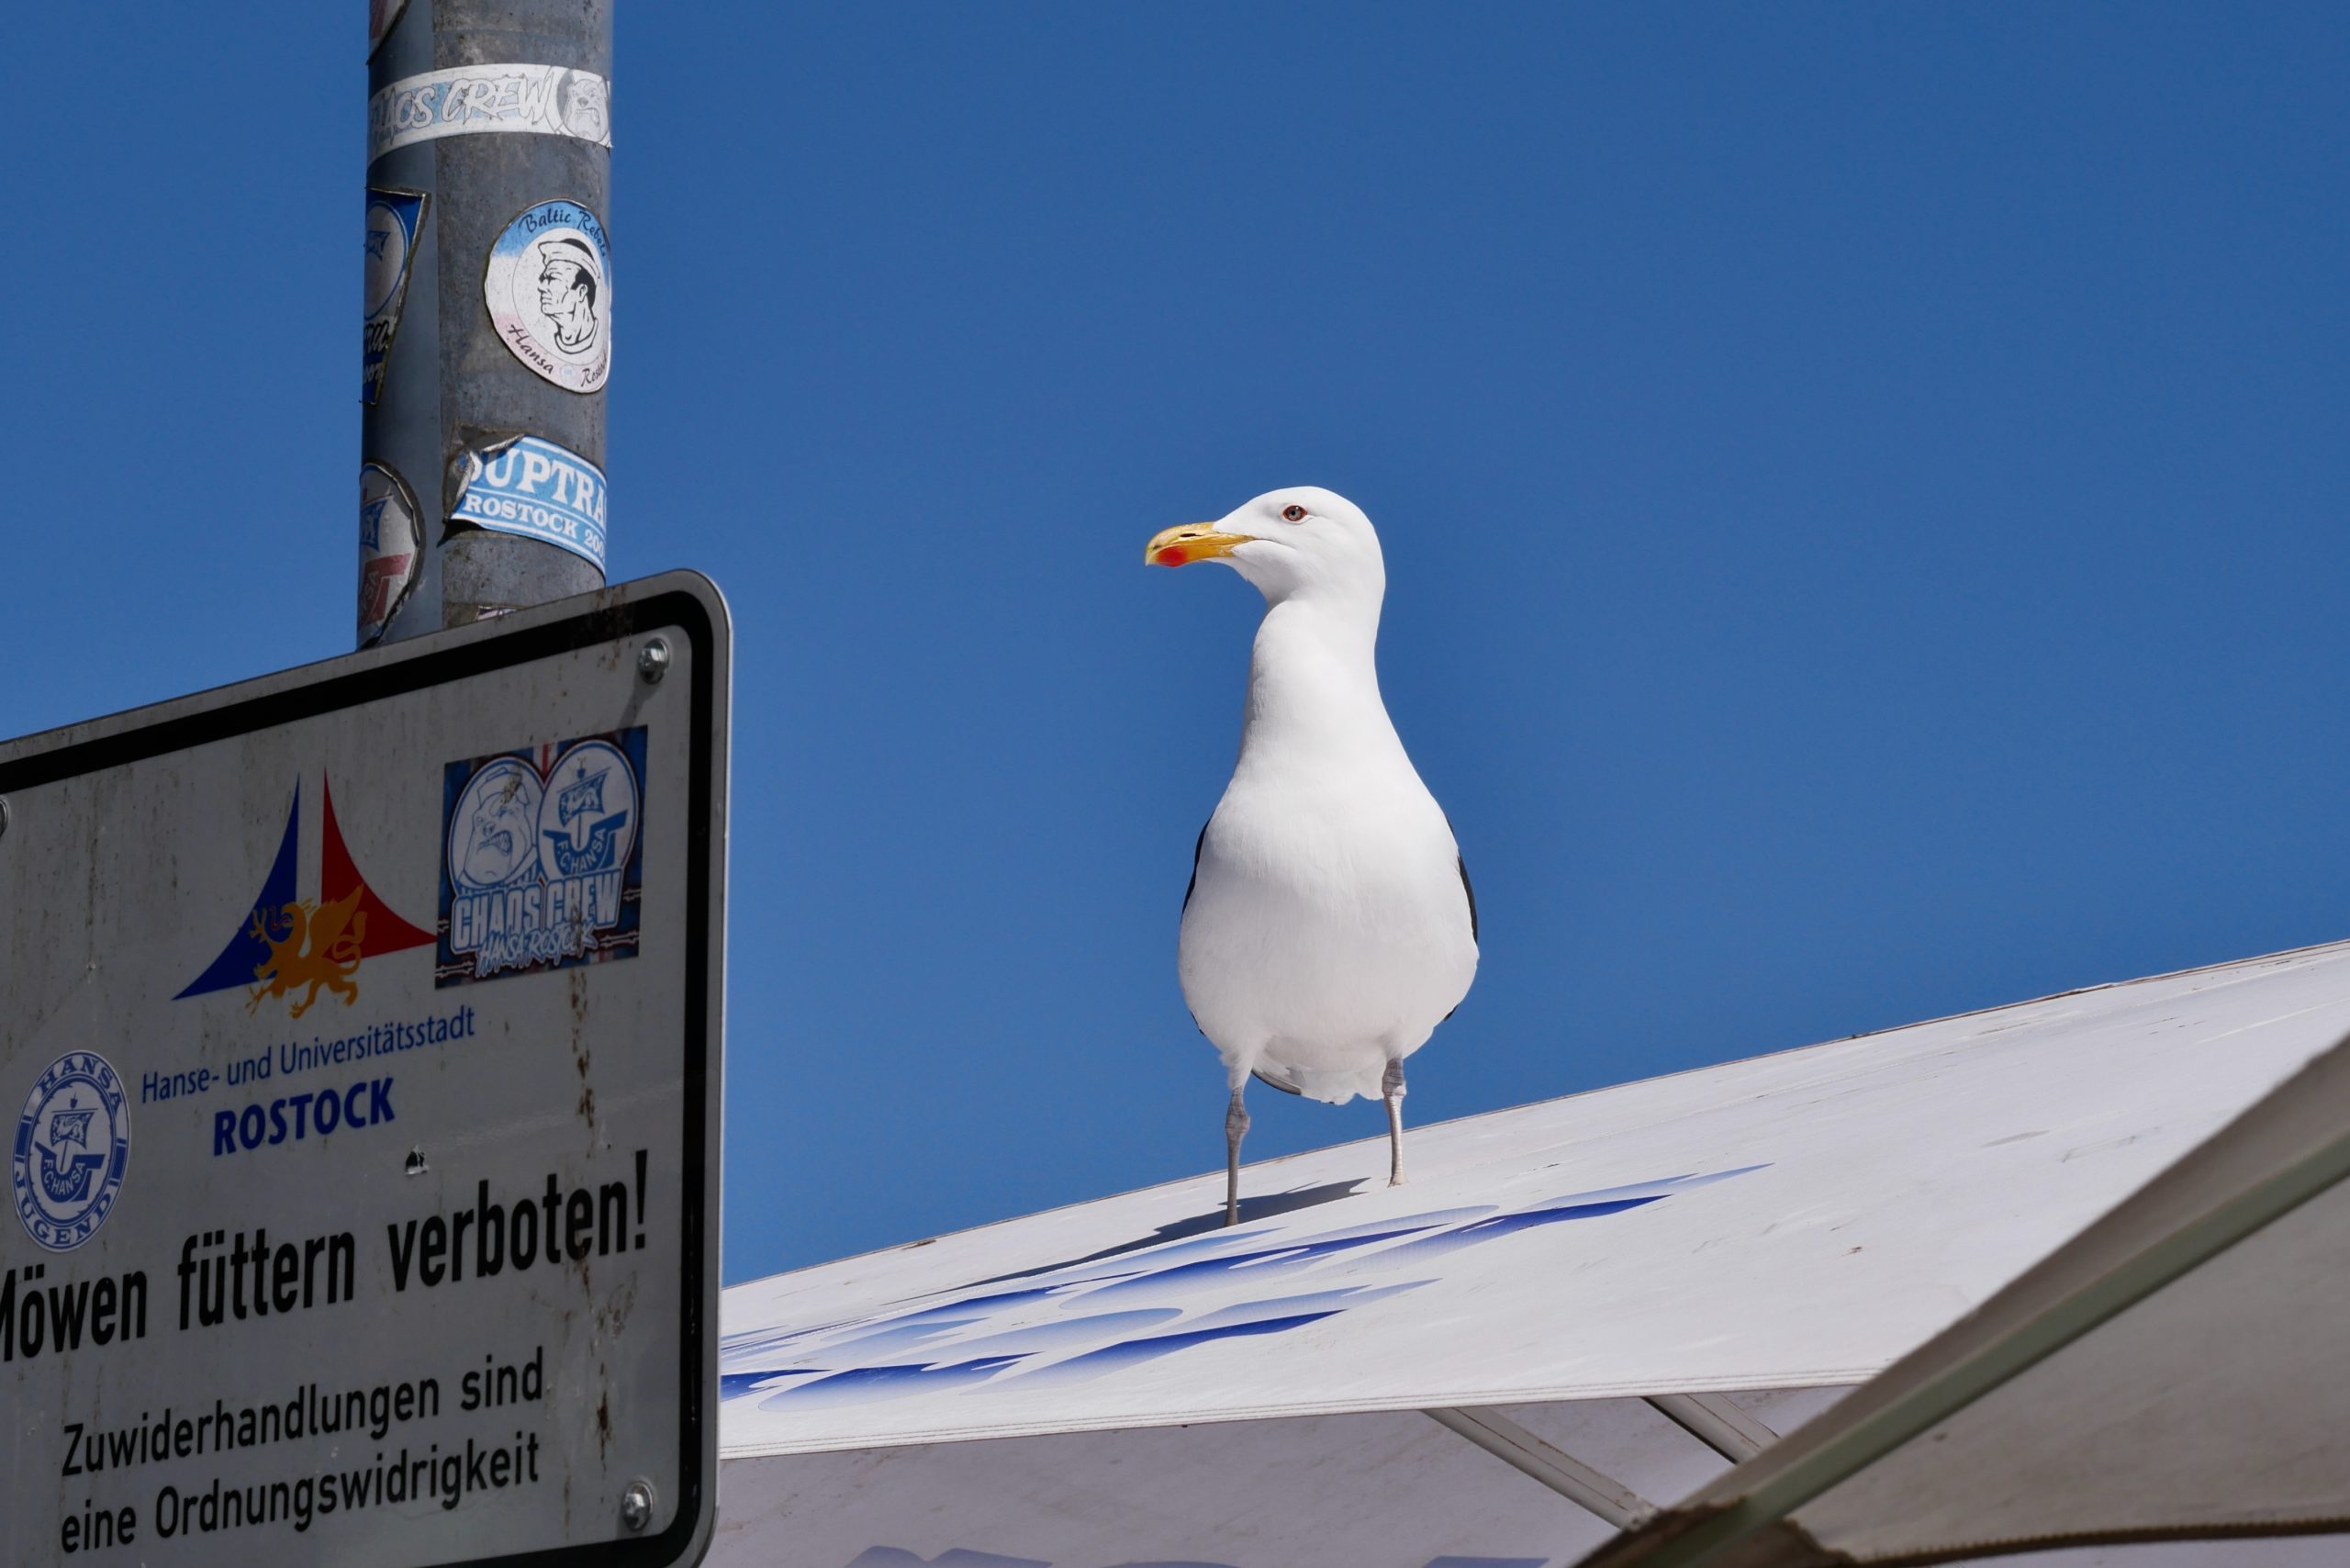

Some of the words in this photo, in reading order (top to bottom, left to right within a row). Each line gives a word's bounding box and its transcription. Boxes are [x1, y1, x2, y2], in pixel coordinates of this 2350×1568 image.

[442, 72, 554, 126] CREW
[518, 207, 571, 233] Baltic
[507, 323, 554, 375] Hansa
[462, 492, 578, 540] ROSTOCK
[453, 883, 542, 950] CHAOS
[546, 871, 621, 930] CREW
[38, 1055, 123, 1115] HANSA
[141, 1068, 220, 1103] Hanse-
[227, 1046, 273, 1086] und
[280, 1004, 476, 1075] Universitätsstadt
[213, 1077, 396, 1158] ROSTOCK
[15, 1169, 112, 1245] JUGEND
[177, 1228, 356, 1331] füttern
[387, 1149, 649, 1293] verboten!
[62, 1375, 440, 1477] Zuwiderhandlungen
[460, 1346, 544, 1412] sind
[61, 1500, 137, 1554] eine
[154, 1430, 540, 1538] Ordnungswidrigkeit
